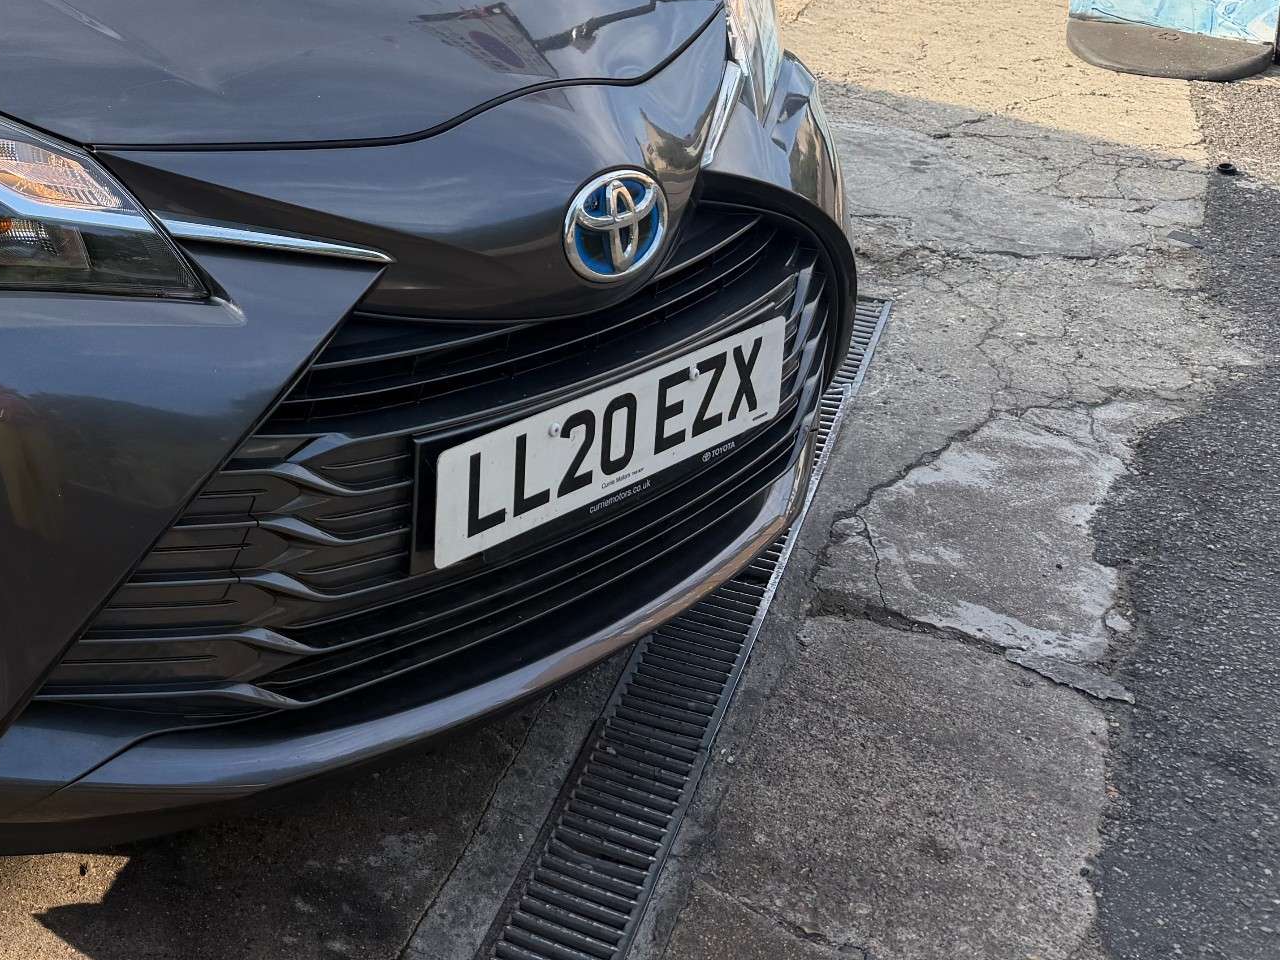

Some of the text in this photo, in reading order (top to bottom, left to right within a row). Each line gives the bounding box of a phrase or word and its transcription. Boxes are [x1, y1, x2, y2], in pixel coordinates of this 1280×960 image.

[467, 335, 764, 539] LL20 EZX
[711, 441, 736, 458] TOYOTA
